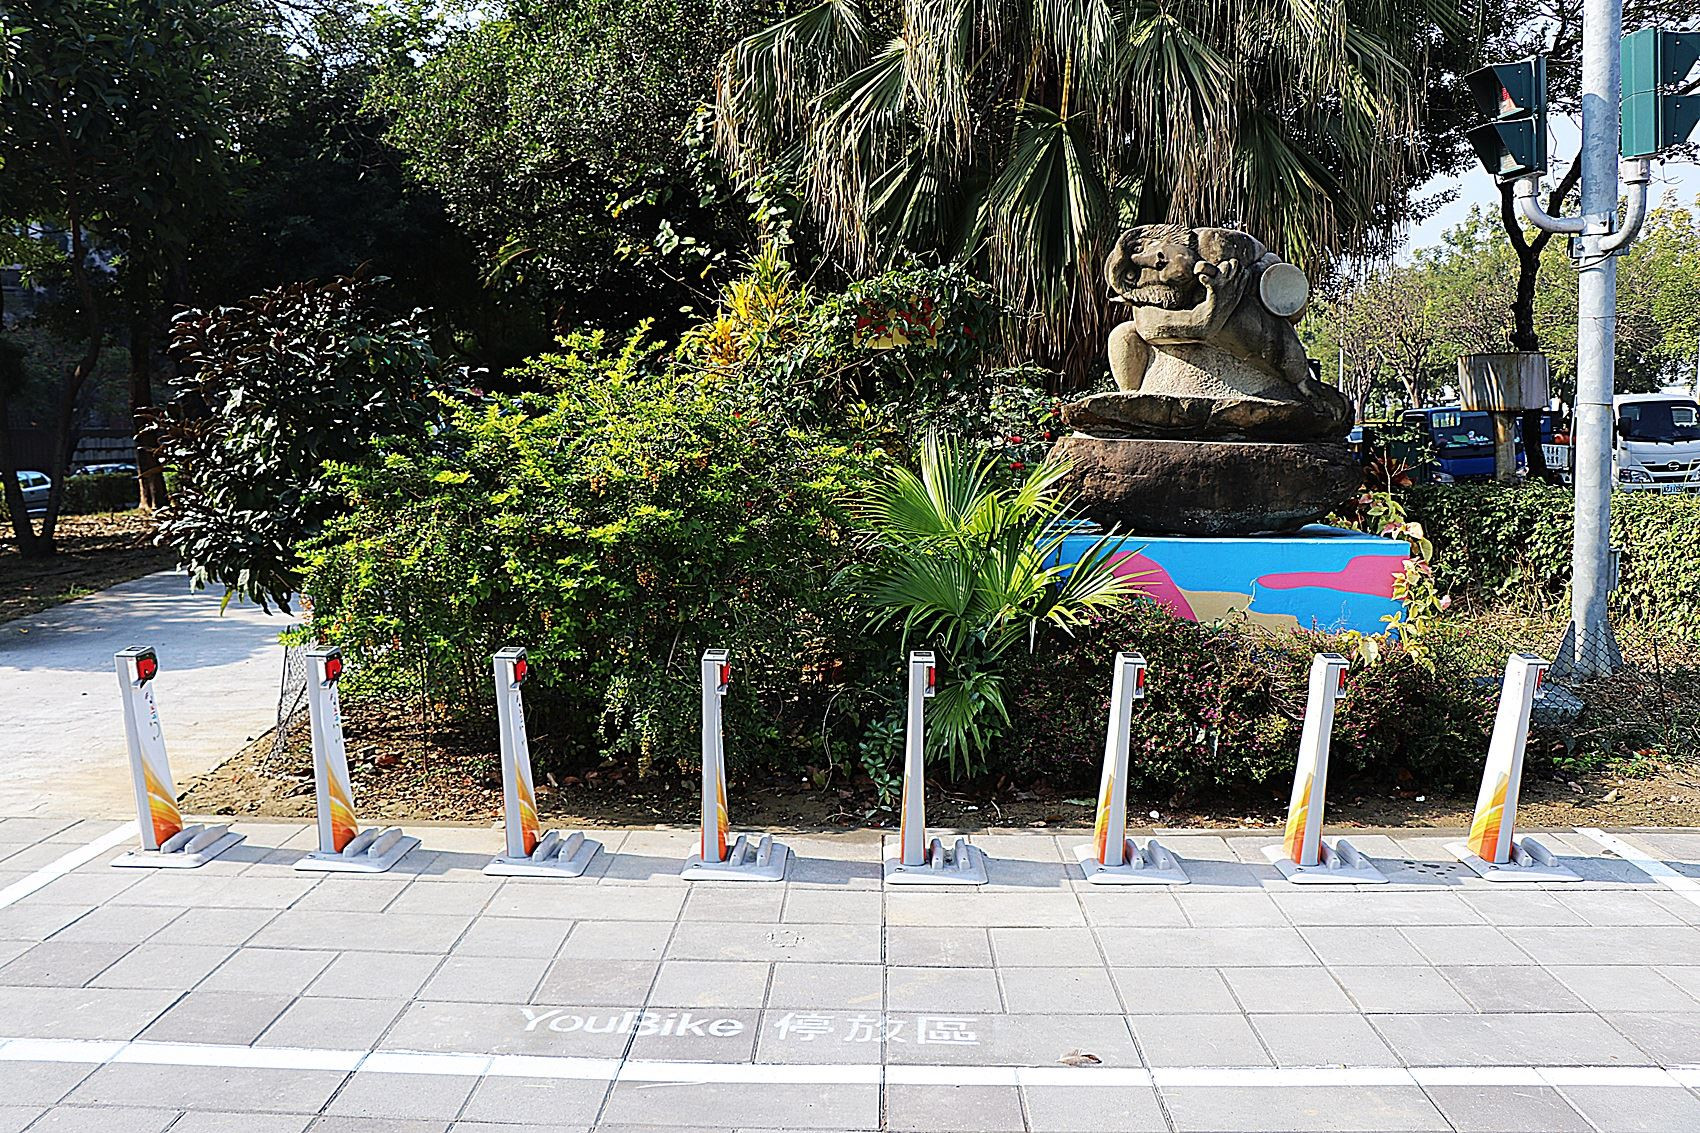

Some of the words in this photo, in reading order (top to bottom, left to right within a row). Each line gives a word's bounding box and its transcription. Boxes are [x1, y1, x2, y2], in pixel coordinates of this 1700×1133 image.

[520, 1008, 744, 1037] YouBike
[773, 1012, 981, 1046] 停放區
